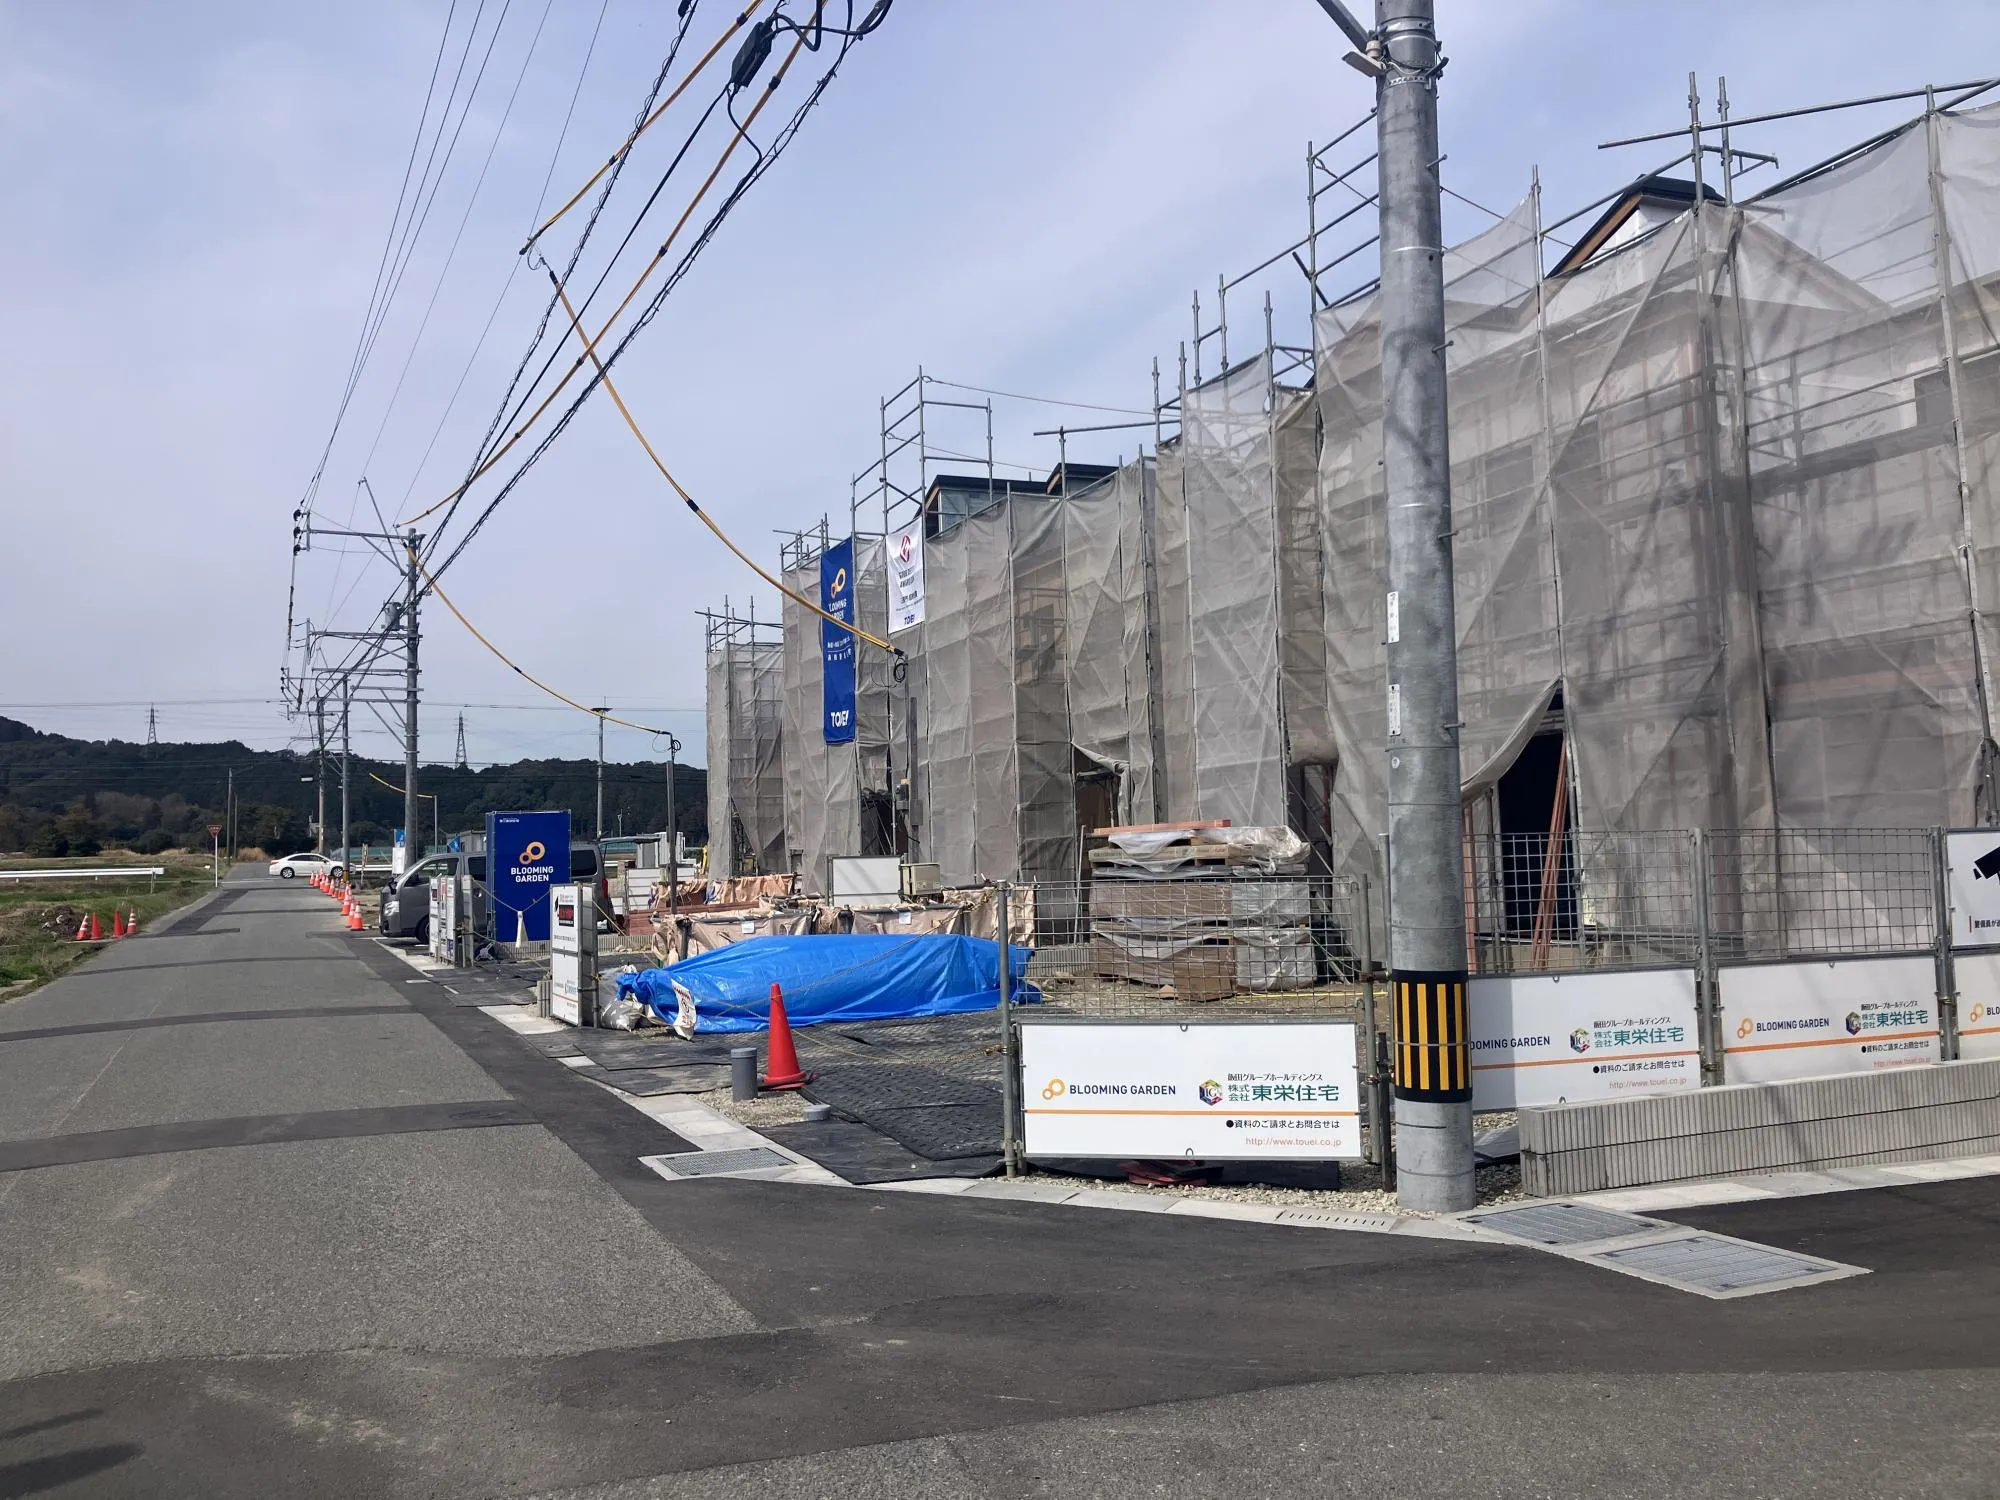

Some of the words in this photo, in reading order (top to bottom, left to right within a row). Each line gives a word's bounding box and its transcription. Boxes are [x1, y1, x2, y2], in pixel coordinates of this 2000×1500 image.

[510, 866, 554, 875] BLOOMING
[515, 874, 549, 883] GARDEN
[1756, 1020, 1797, 1032] BLOOMING
[1798, 1018, 1830, 1029] GARDEN
[1876, 1010, 1928, 1028] 東栄住宅
[1470, 1038, 1508, 1050] OOMING
[1510, 1036, 1550, 1047] GARDEN
[1613, 1026, 1684, 1046] 東栄住宅
[1069, 1084, 1128, 1095] BLOOMING
[1130, 1085, 1176, 1095] GARDEN
[1251, 1084, 1340, 1102] 東栄住宅
[1234, 1119, 1340, 1129] 資料のご請求とお問合せは
